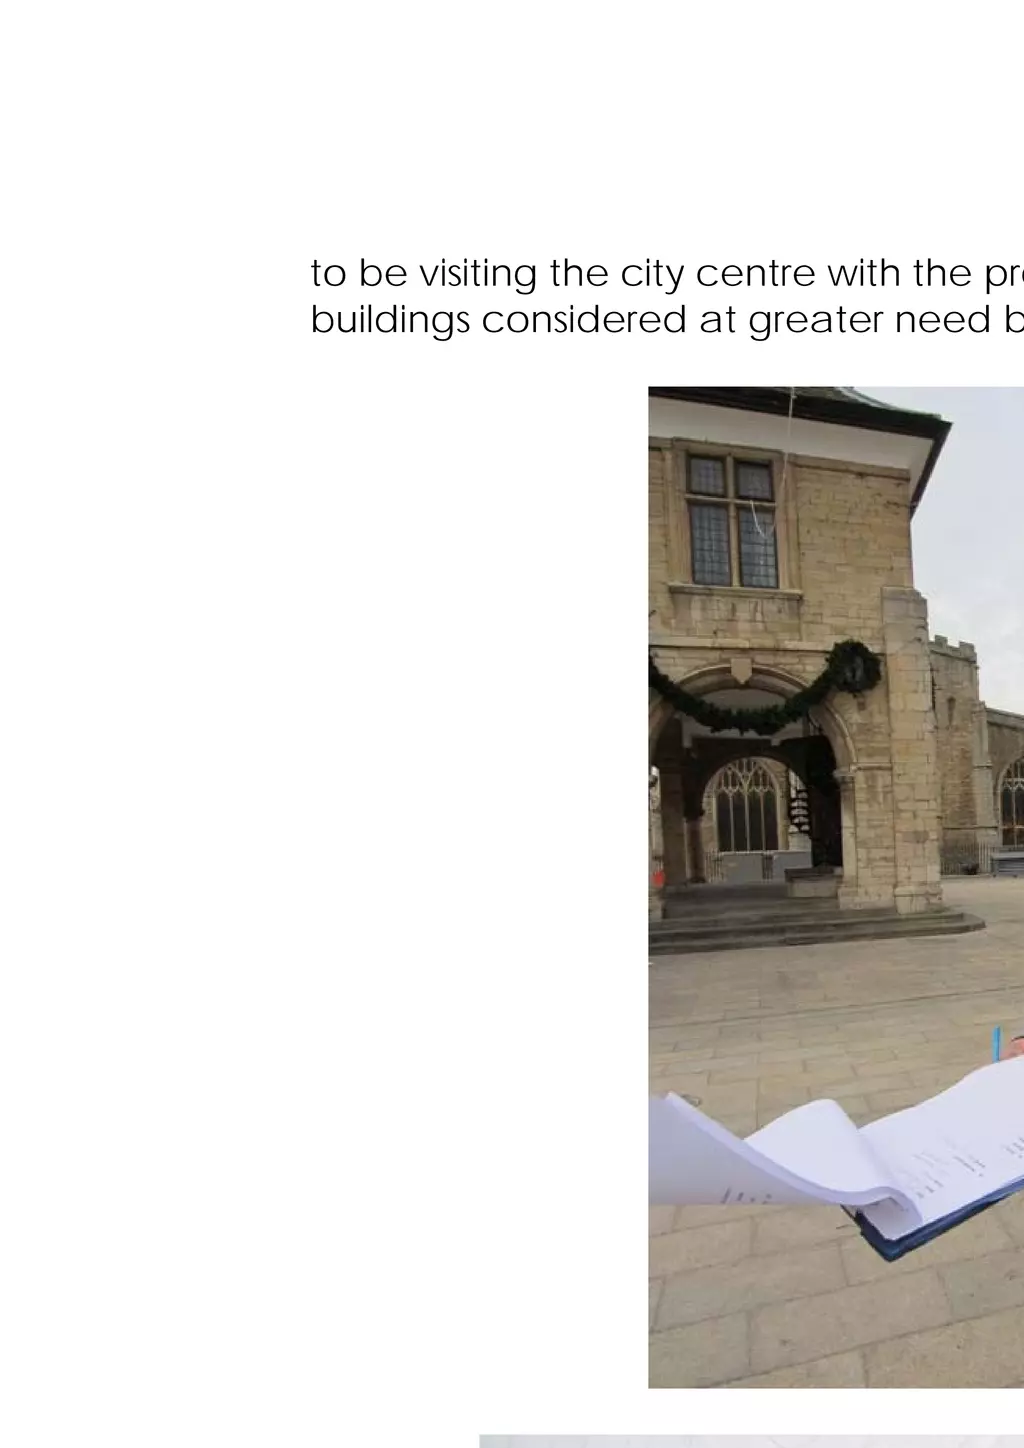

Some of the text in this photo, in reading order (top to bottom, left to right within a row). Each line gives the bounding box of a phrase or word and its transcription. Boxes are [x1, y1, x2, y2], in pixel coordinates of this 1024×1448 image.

[311, 260, 346, 286] to
[361, 258, 407, 286] be
[420, 258, 535, 295] visiting
[550, 258, 608, 286] the
[622, 258, 684, 295] city
[697, 260, 815, 286] centre
[828, 258, 899, 286] with
[913, 258, 971, 286] the
[313, 304, 470, 341] buildings
[483, 305, 685, 333] considered
[701, 306, 736, 333] at
[750, 306, 884, 341] greater
[897, 305, 989, 333] need
